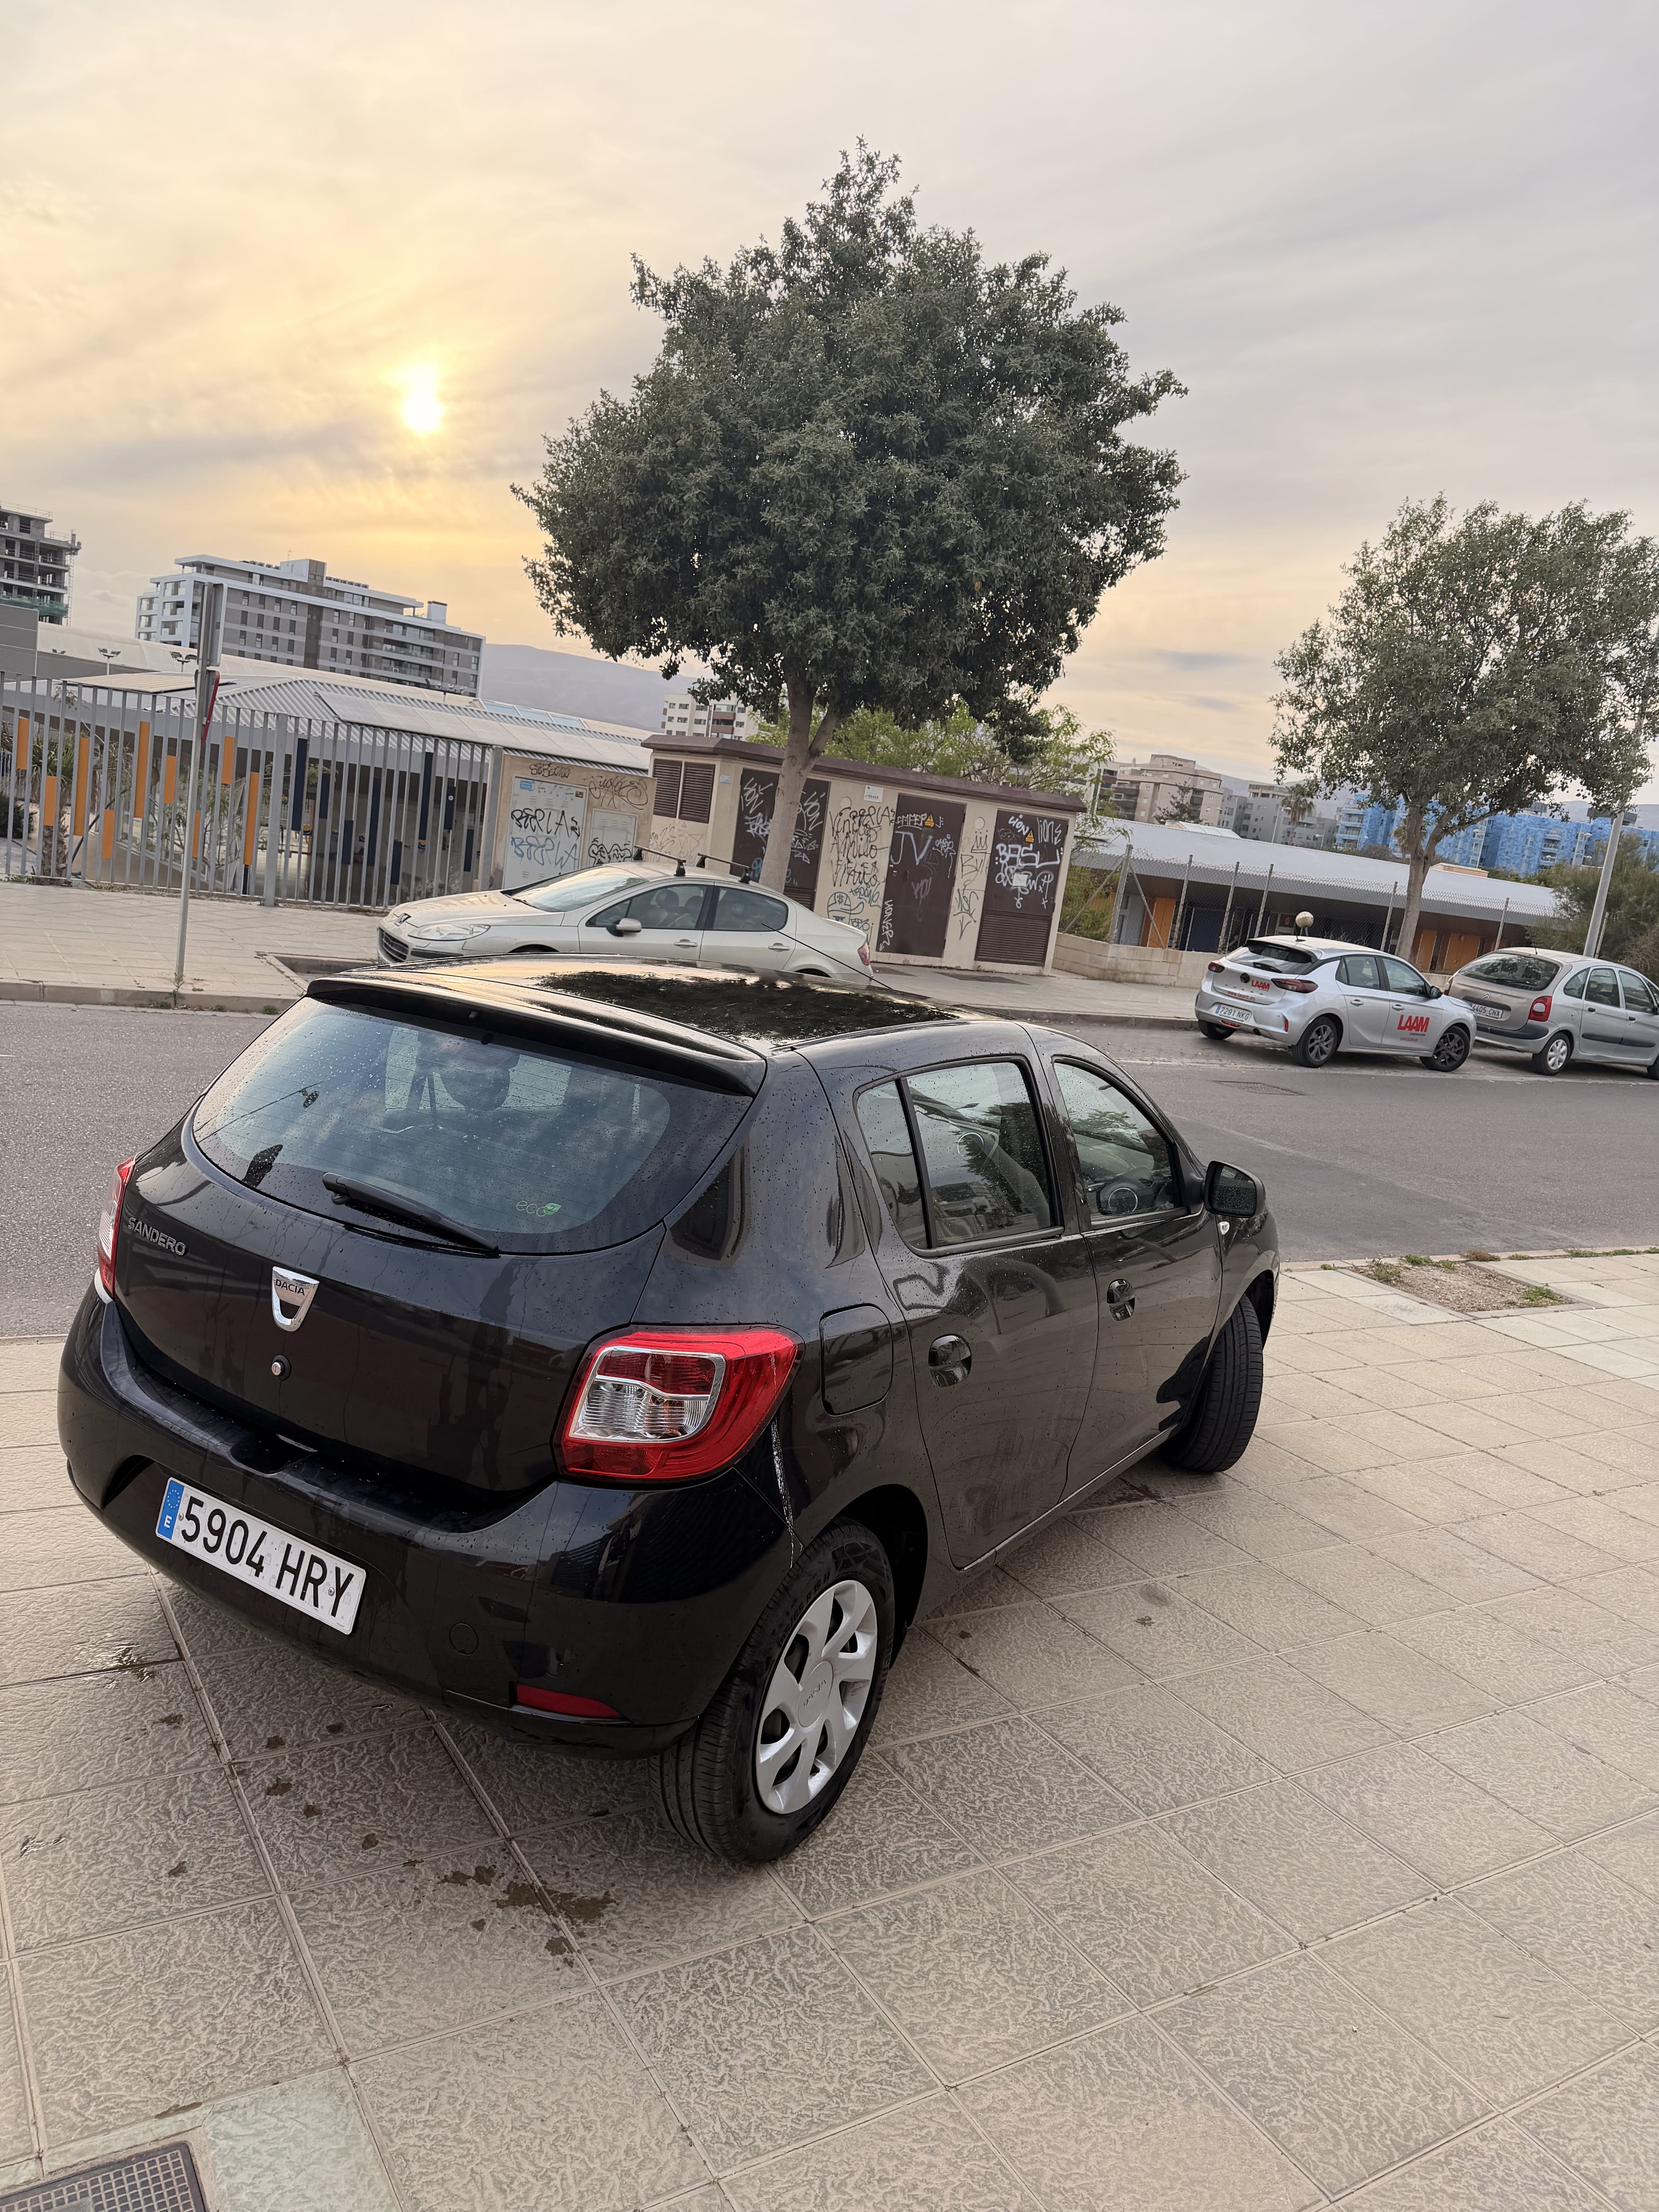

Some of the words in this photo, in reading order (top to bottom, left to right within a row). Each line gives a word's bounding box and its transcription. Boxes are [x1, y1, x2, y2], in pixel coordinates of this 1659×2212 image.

[1251, 979, 1270, 991] LAAM
[1220, 1006, 1236, 1016] 7291
[1236, 1011, 1250, 1020] NKG
[1472, 1004, 1487, 1013] 4405
[1488, 1008, 1501, 1017] CNX
[1397, 1014, 1430, 1032] LAAM
[128, 1217, 187, 1256] SANDERO
[275, 1279, 305, 1296] DACIA
[163, 1515, 172, 1529] E
[181, 1496, 268, 1578] 5904
[275, 1543, 354, 1618] HRY
